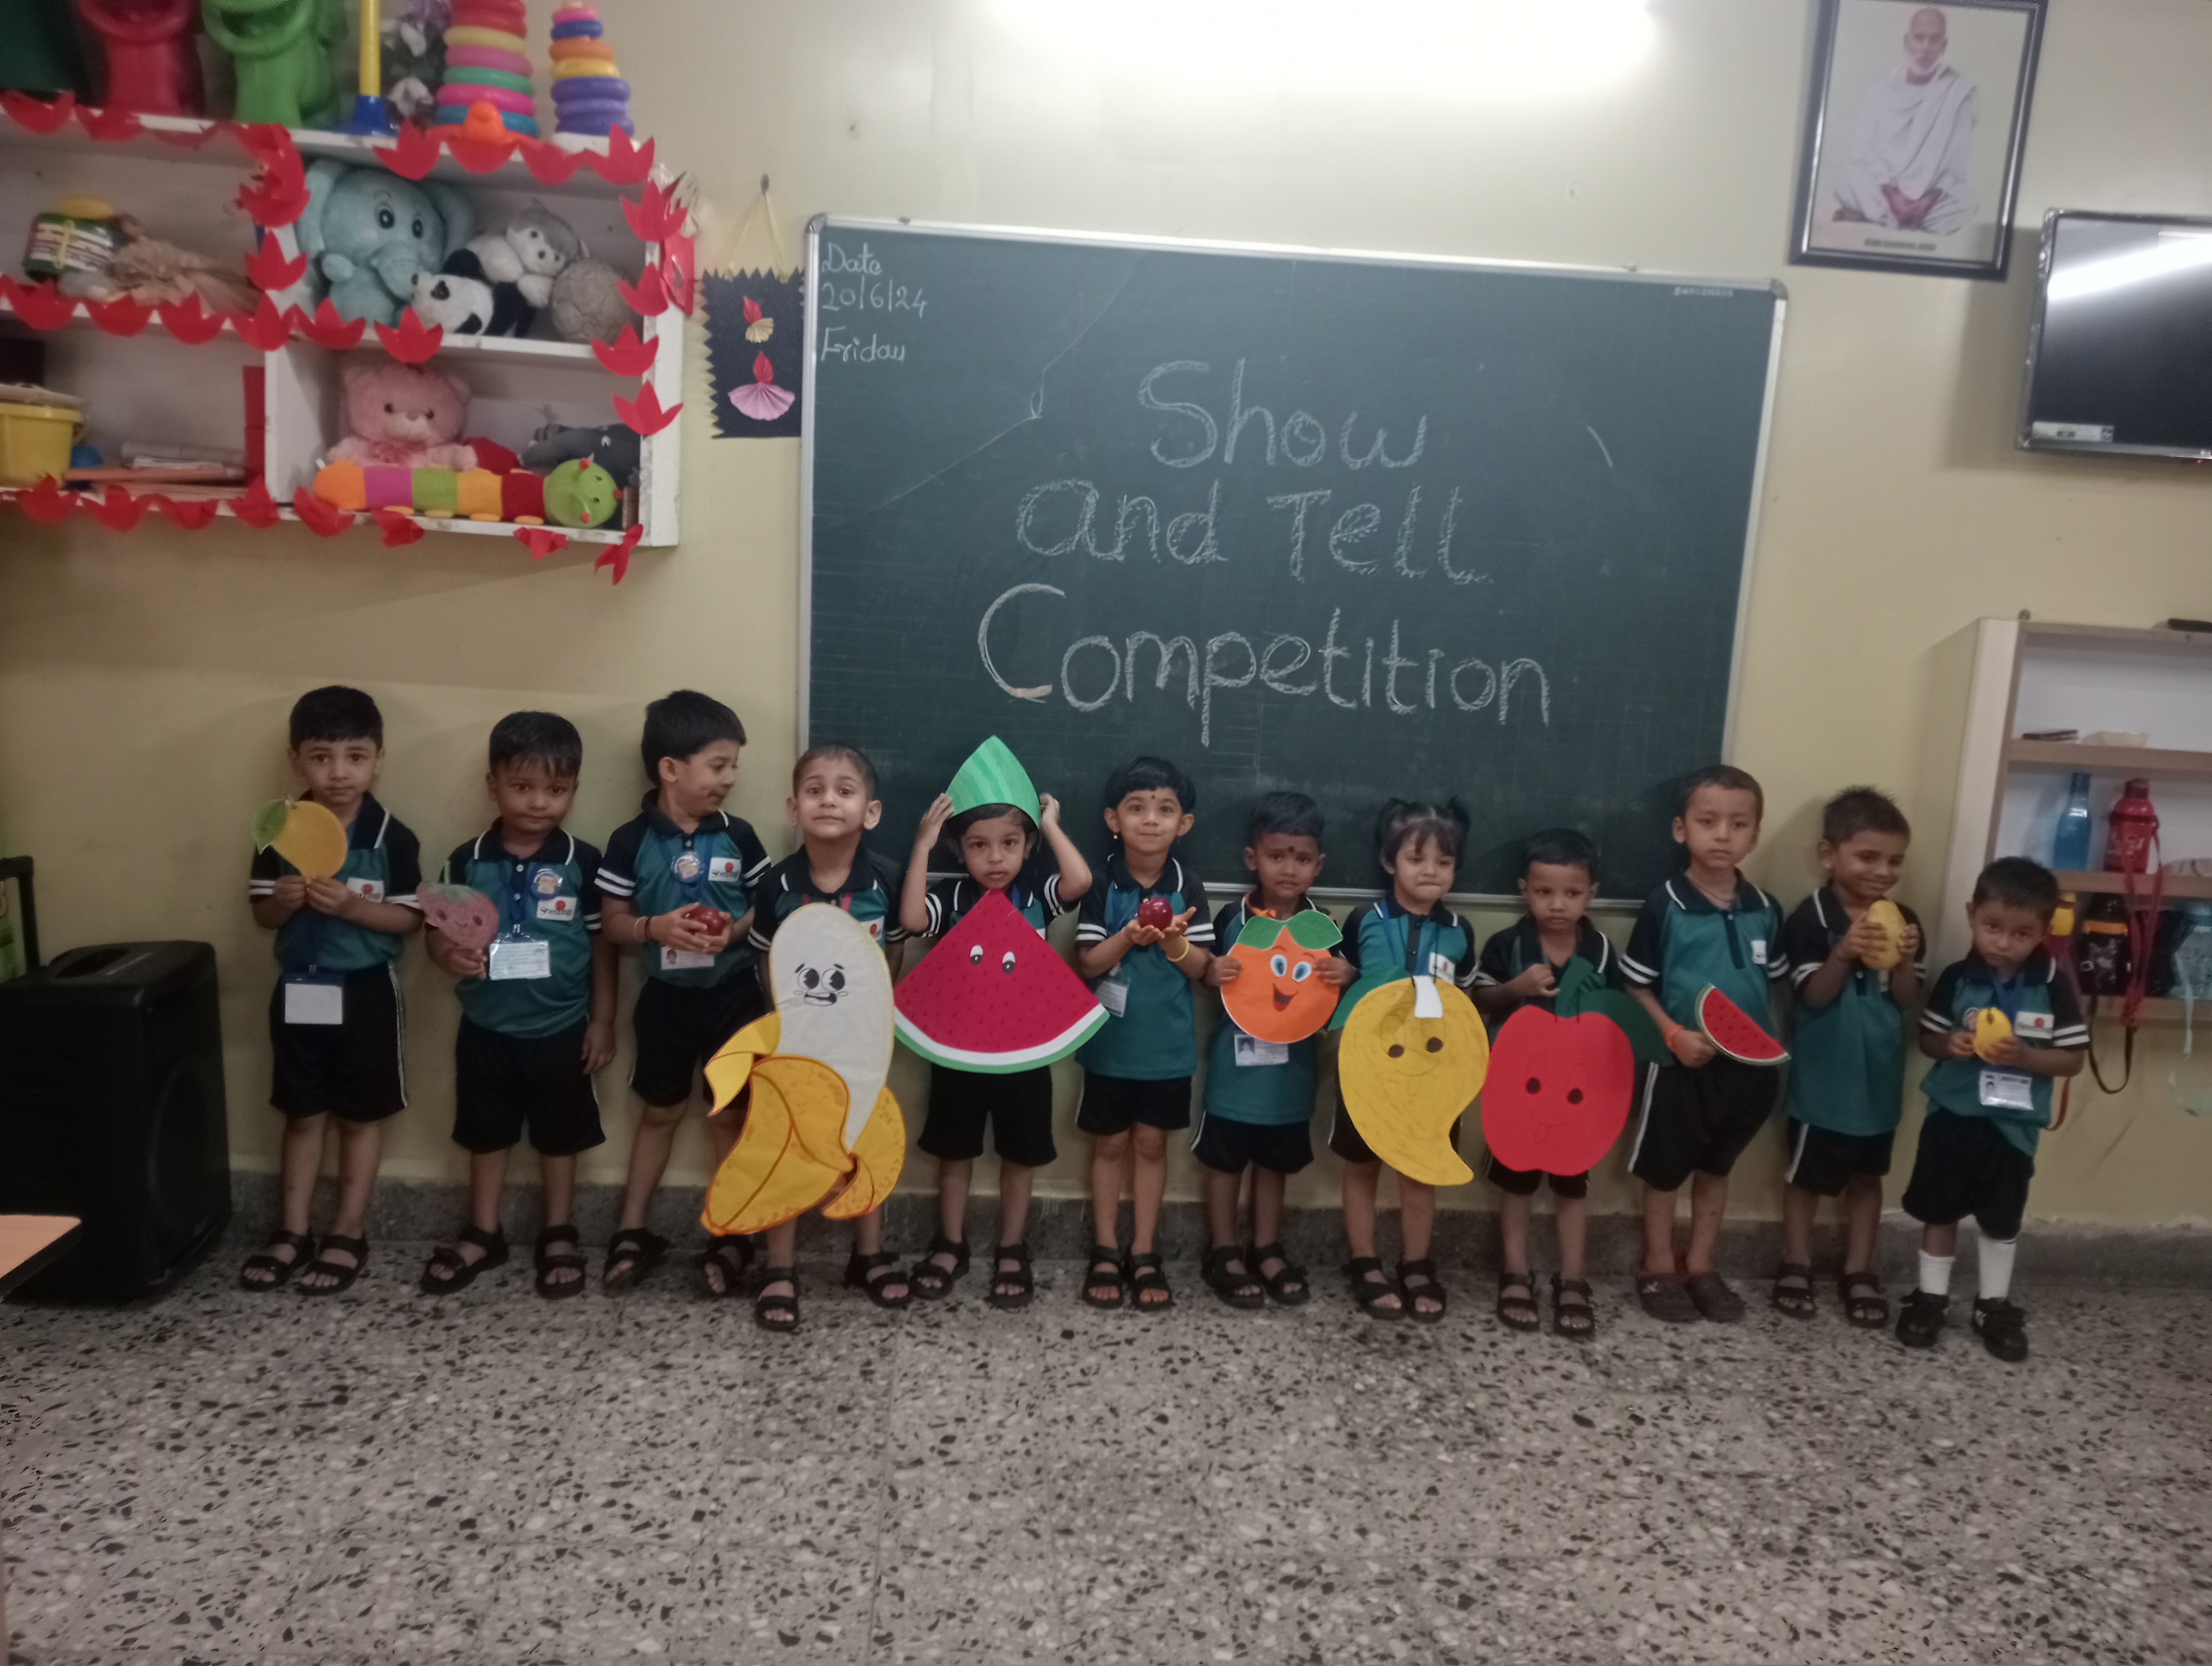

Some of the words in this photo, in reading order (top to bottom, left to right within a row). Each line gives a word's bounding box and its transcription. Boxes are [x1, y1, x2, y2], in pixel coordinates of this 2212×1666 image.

[821, 242, 883, 275] Date
[1137, 356, 1428, 470] Show
[1266, 484, 1495, 585] Tell
[978, 582, 1550, 748] Competition
